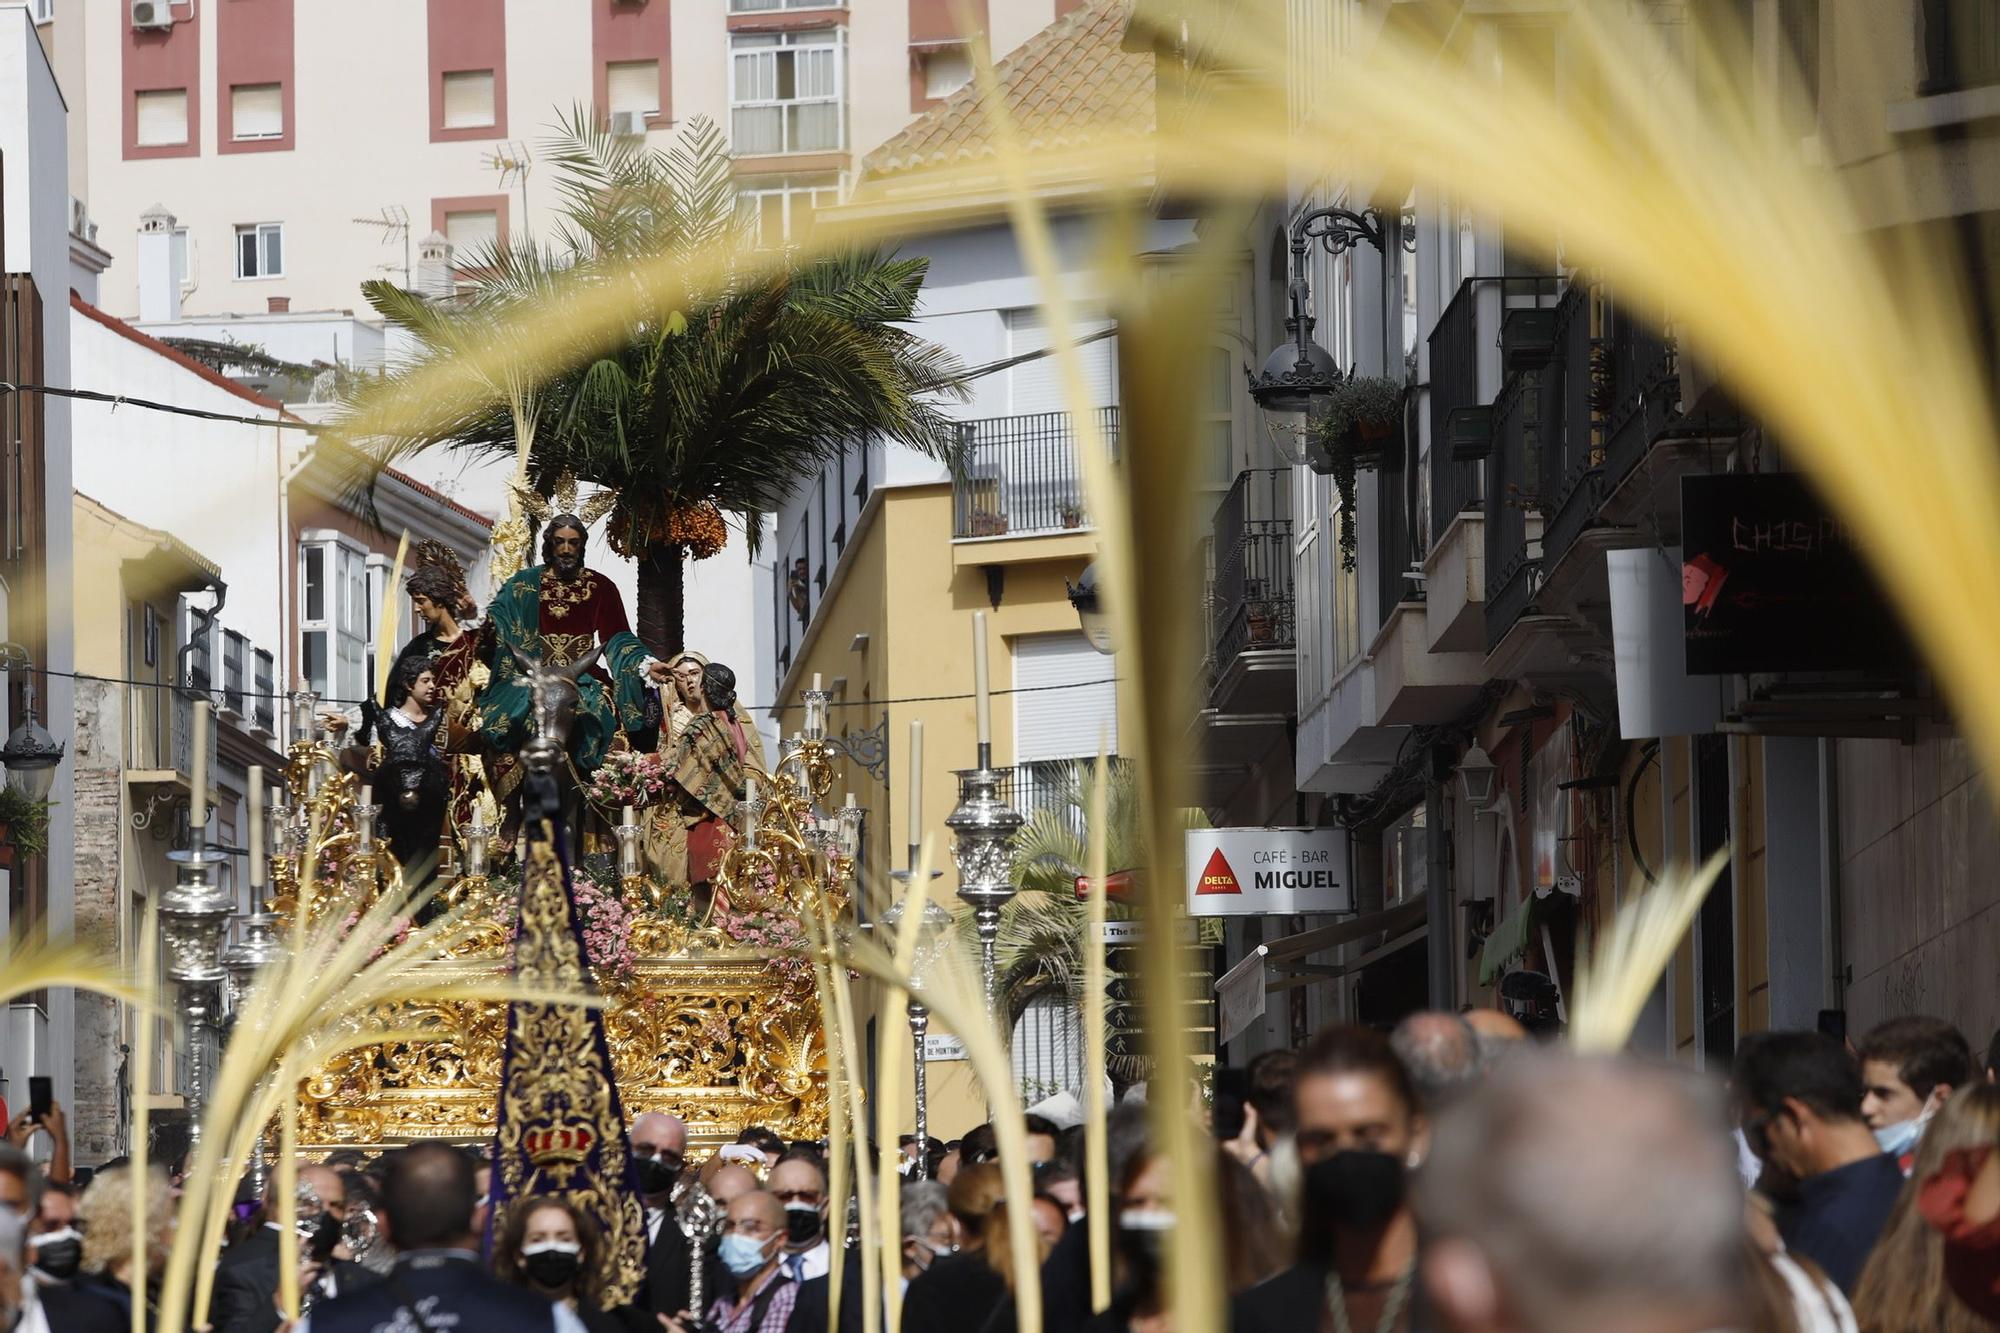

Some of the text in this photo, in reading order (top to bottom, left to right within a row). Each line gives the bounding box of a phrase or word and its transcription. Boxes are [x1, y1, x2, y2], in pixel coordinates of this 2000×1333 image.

[1253, 848, 1287, 864] CAFÉ
[1302, 850, 1329, 864] BAR
[1204, 875, 1234, 885] DELTA
[1254, 870, 1340, 890] MIGUEL
[1109, 927, 1129, 936] The
[927, 1047, 935, 1056] DE
